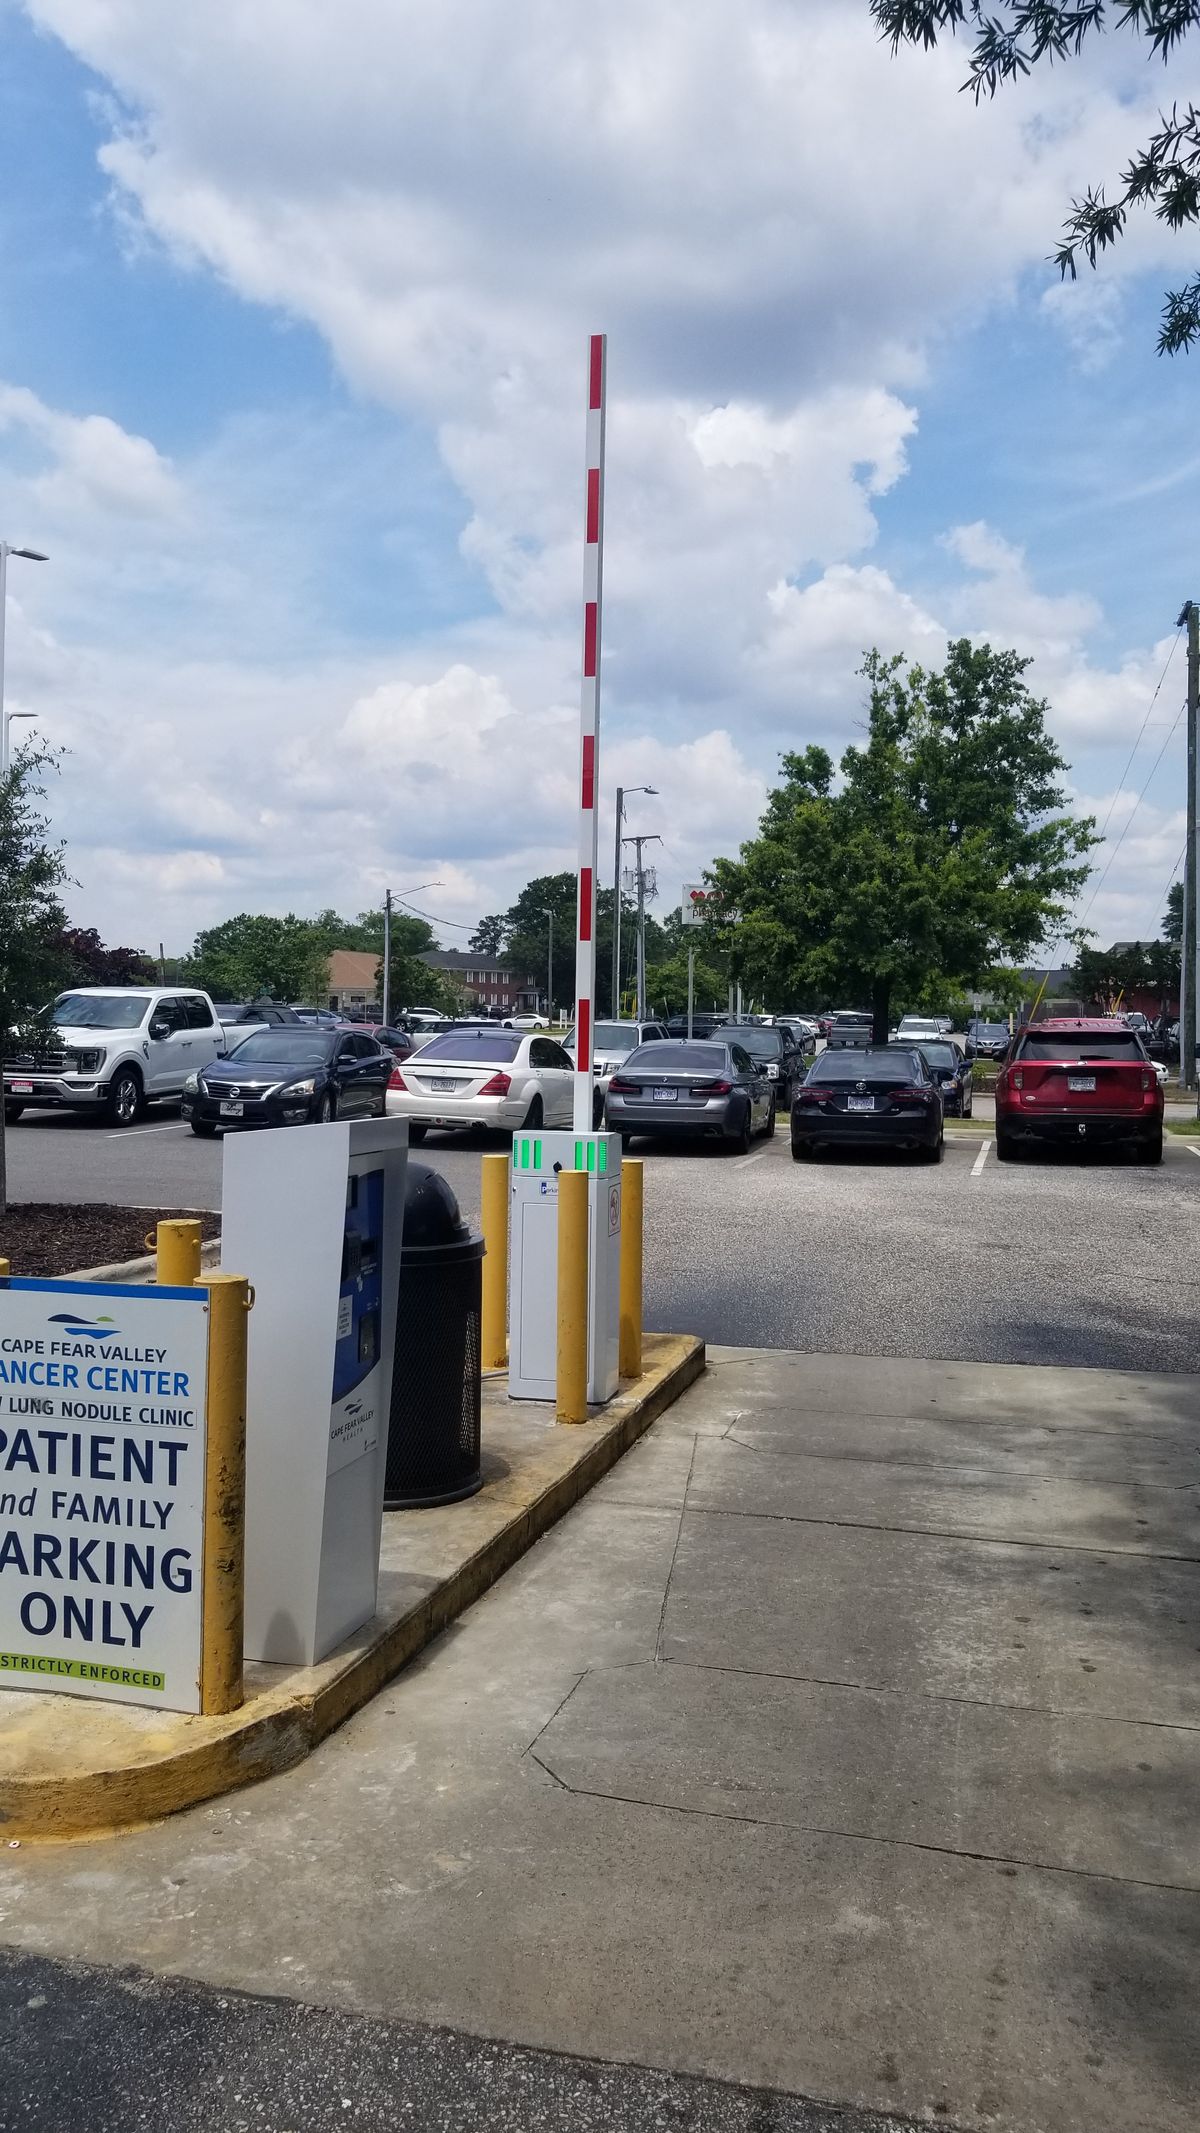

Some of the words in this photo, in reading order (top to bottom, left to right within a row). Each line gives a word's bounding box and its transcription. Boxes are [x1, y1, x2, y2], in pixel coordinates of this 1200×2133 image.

[1, 1338, 45, 1355] CAPE
[51, 1341, 96, 1359] FEAR
[100, 1345, 167, 1363] VALLEY
[0, 1360, 79, 1388] ANCER
[87, 1366, 189, 1397] CENTER
[9, 1397, 54, 1415] LUNG
[62, 1401, 132, 1422] NODULE
[139, 1407, 194, 1427] CLINIC
[331, 1425, 343, 1440] CAPE
[344, 1419, 357, 1432] FEAR
[357, 1409, 374, 1425] VALLEY
[342, 1427, 363, 1442] HEALTH
[0, 1487, 38, 1517] nd
[52, 1491, 175, 1530] FAMILY
[0, 1531, 192, 1593] ARKING
[20, 1591, 154, 1648] ONLY
[1, 1655, 73, 1674] STRICTLY
[80, 1664, 162, 1687] ENFORCED
